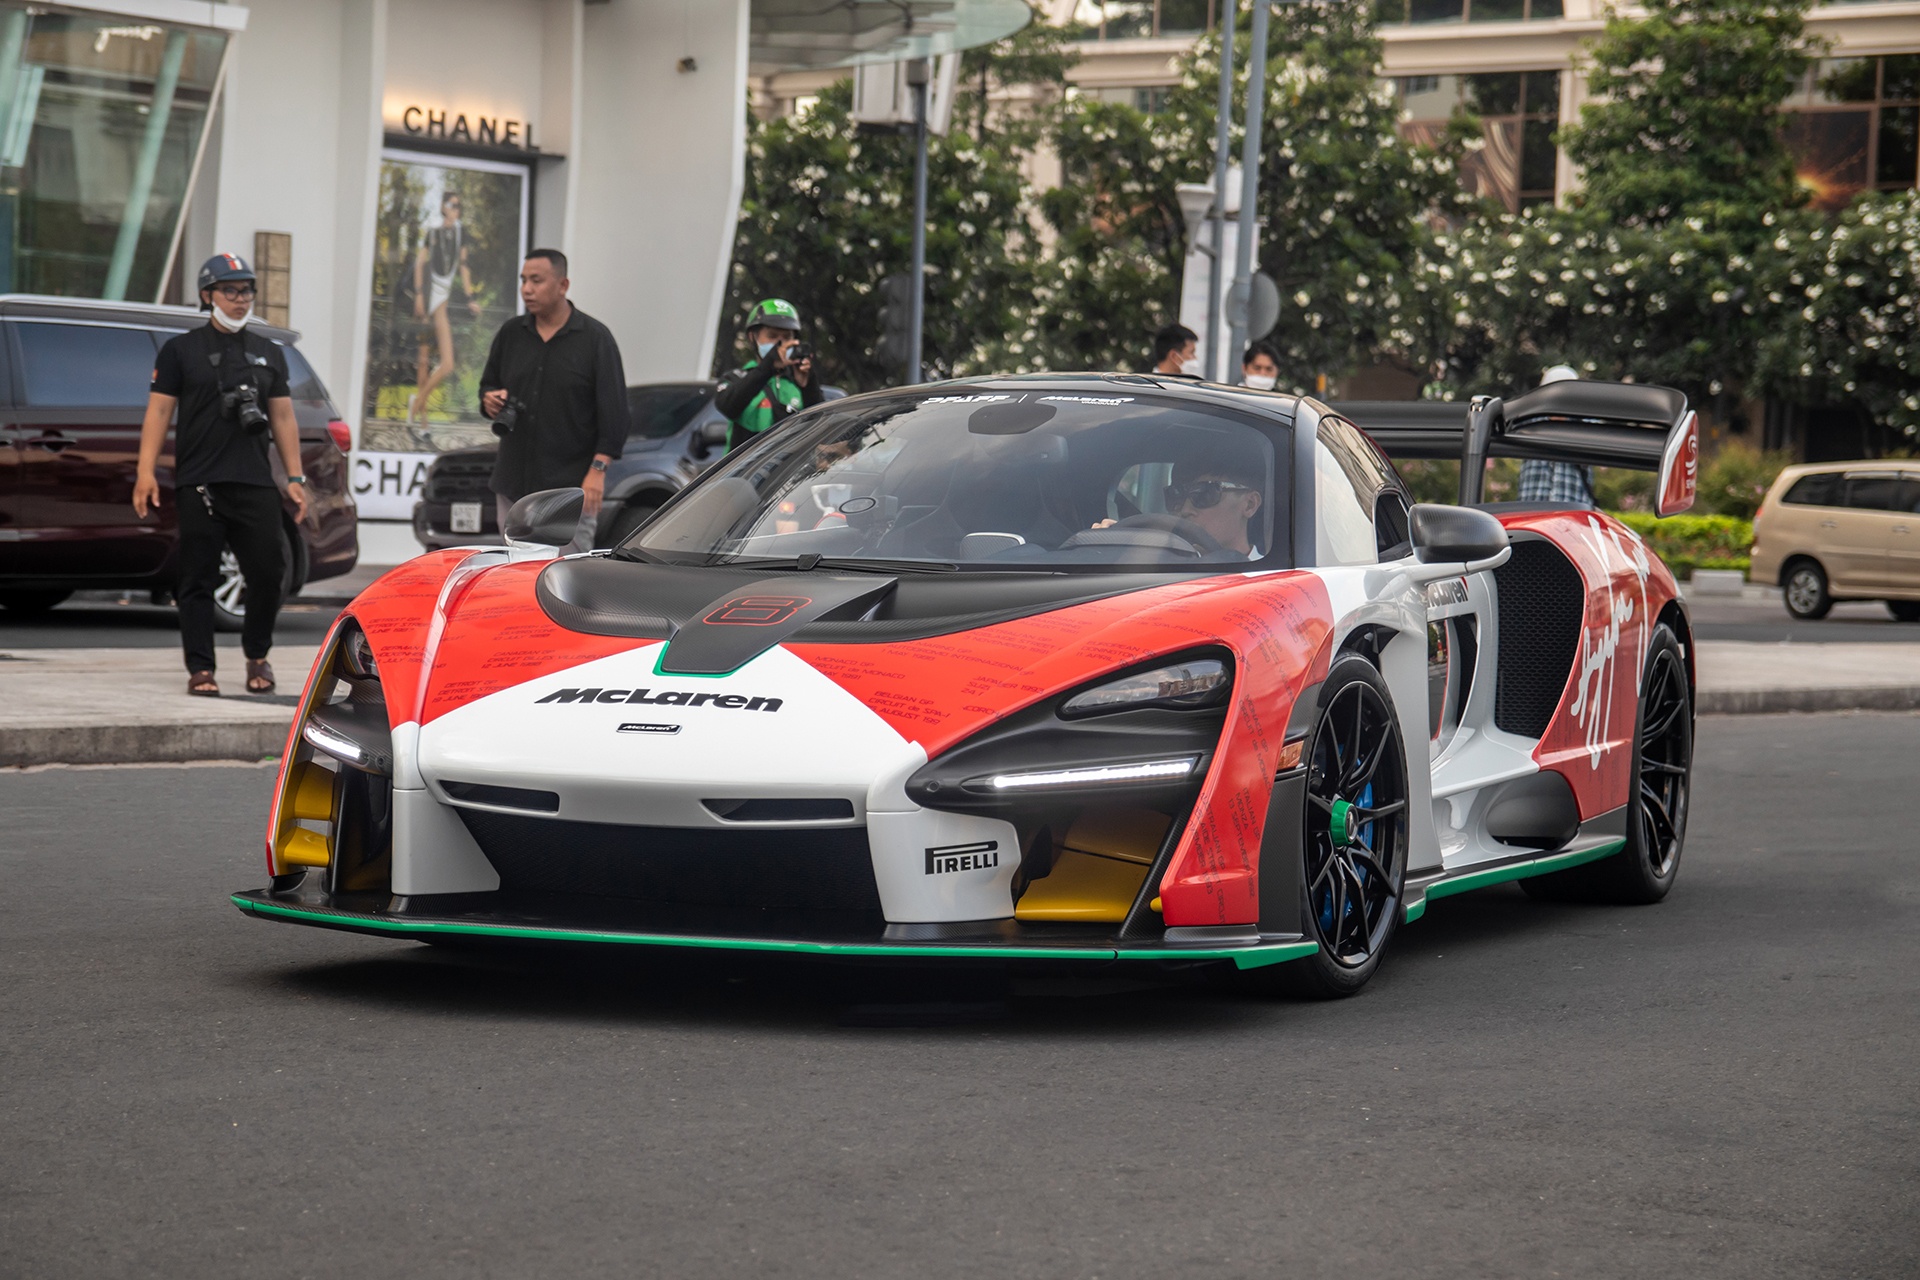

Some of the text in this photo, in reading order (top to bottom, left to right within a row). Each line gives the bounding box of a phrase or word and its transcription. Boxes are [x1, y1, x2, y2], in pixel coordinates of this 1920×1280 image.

[403, 106, 541, 151] CHANEL
[814, 656, 858, 666] MONACO
[810, 661, 846, 670] CIRCUIT
[862, 669, 906, 680] MONACO
[438, 687, 477, 696] DETROIT
[444, 680, 482, 688] DETROIT
[533, 688, 784, 713] McLaren
[868, 697, 906, 708] CIRCUIT
[874, 690, 934, 706] BELGIAN GP
[880, 707, 920, 720] AUGUST
[622, 724, 675, 732] McLaren
[1235, 792, 1249, 830] MONZA
[1242, 787, 1256, 825] ITALIAN
[925, 840, 998, 875] PIRELLI
